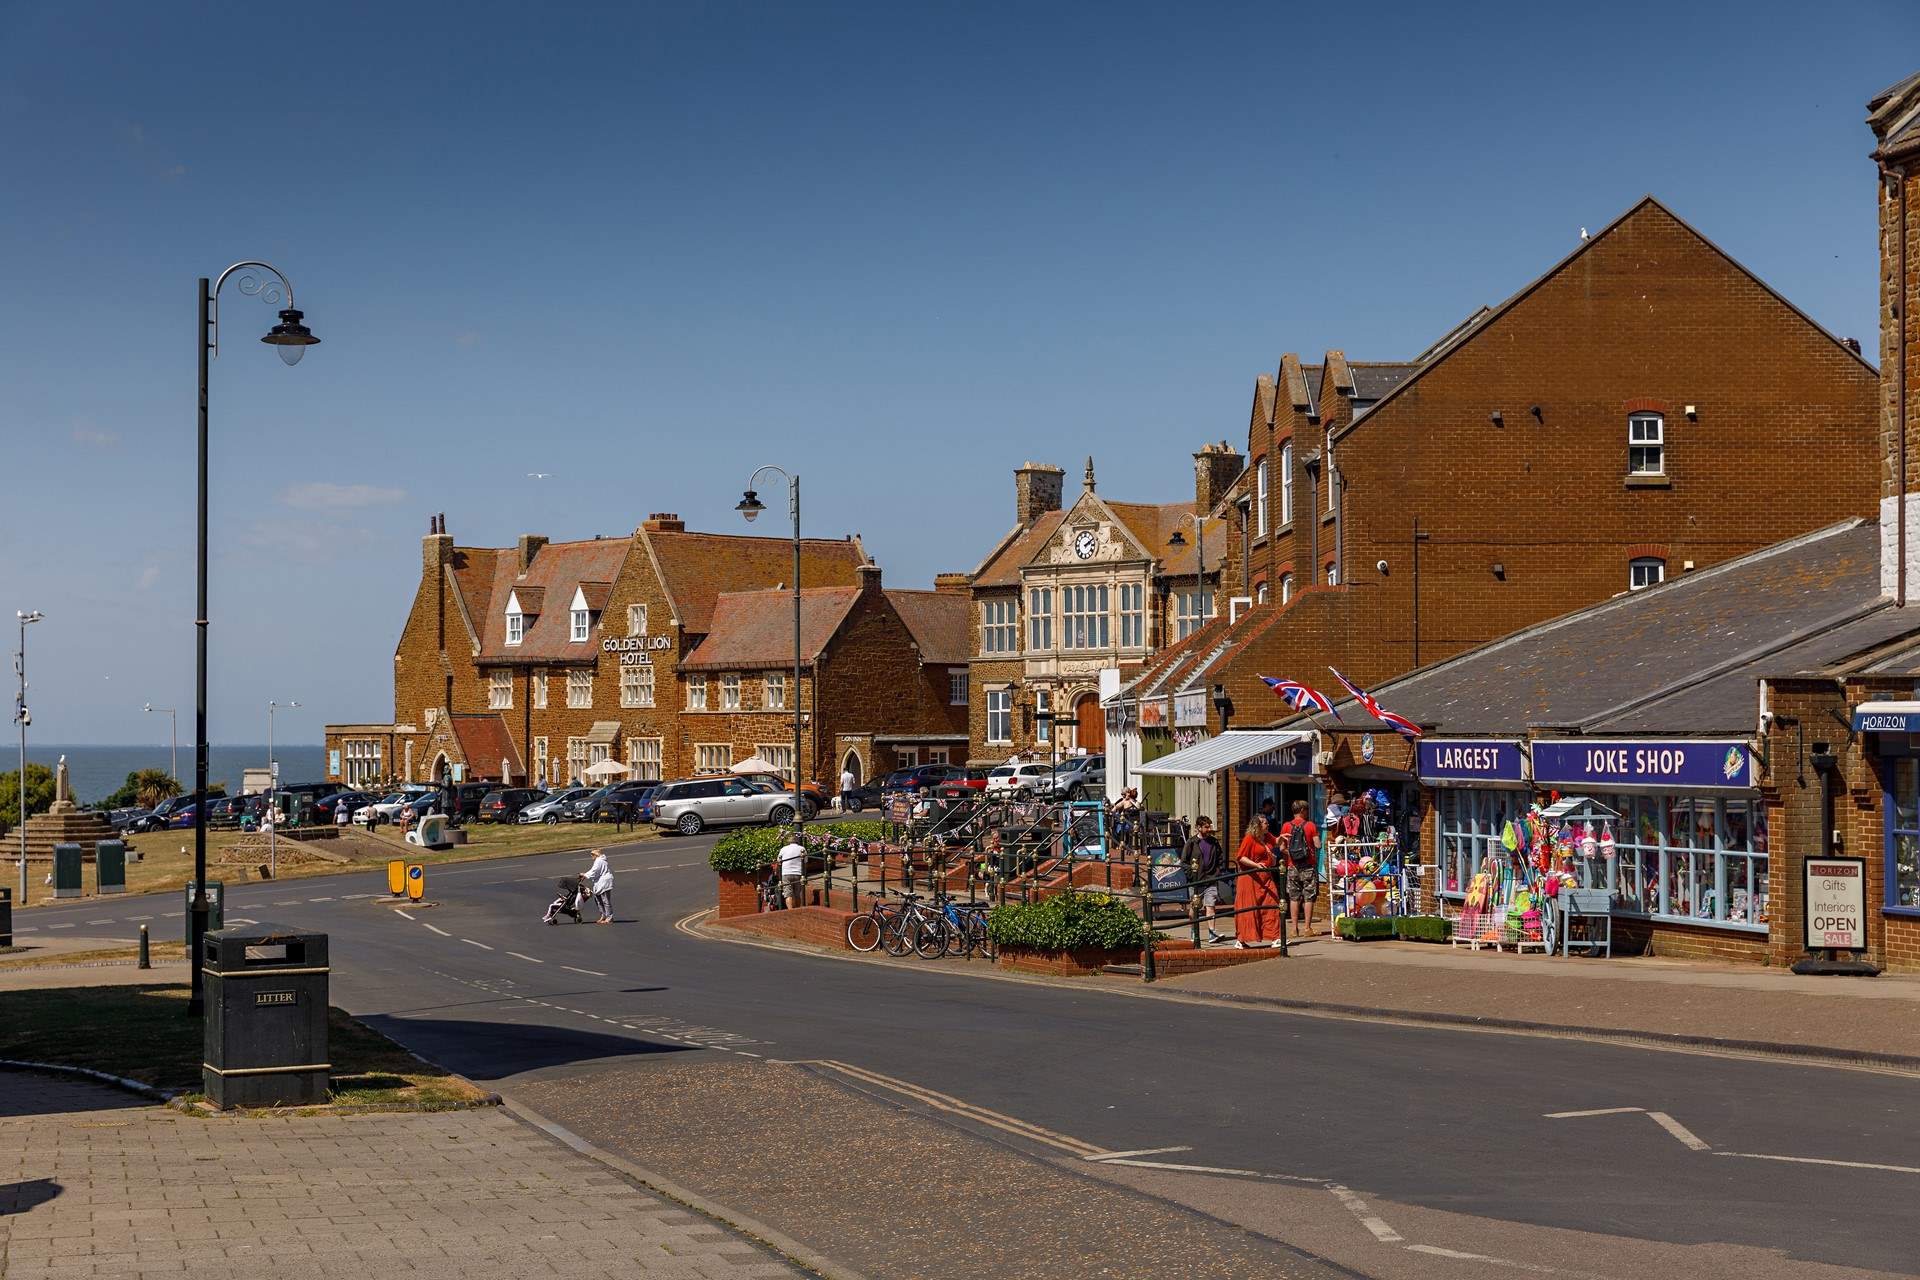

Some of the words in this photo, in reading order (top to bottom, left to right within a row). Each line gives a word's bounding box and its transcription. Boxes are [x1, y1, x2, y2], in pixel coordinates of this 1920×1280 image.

[603, 637, 644, 652] GOLDEN
[648, 637, 671, 649] LION
[620, 652, 653, 665] HOTEL
[1861, 716, 1906, 730] HORIZON
[1436, 748, 1499, 769] LARGEST
[1585, 750, 1629, 773] JOKE
[1635, 750, 1685, 774] SHOP
[1157, 881, 1181, 890] OPEN
[1822, 879, 1847, 891] Gifts
[1814, 901, 1856, 913] Interiors
[1814, 917, 1857, 931] OPEN
[1825, 934, 1851, 945] SALE
[256, 993, 293, 1003] LITTER
